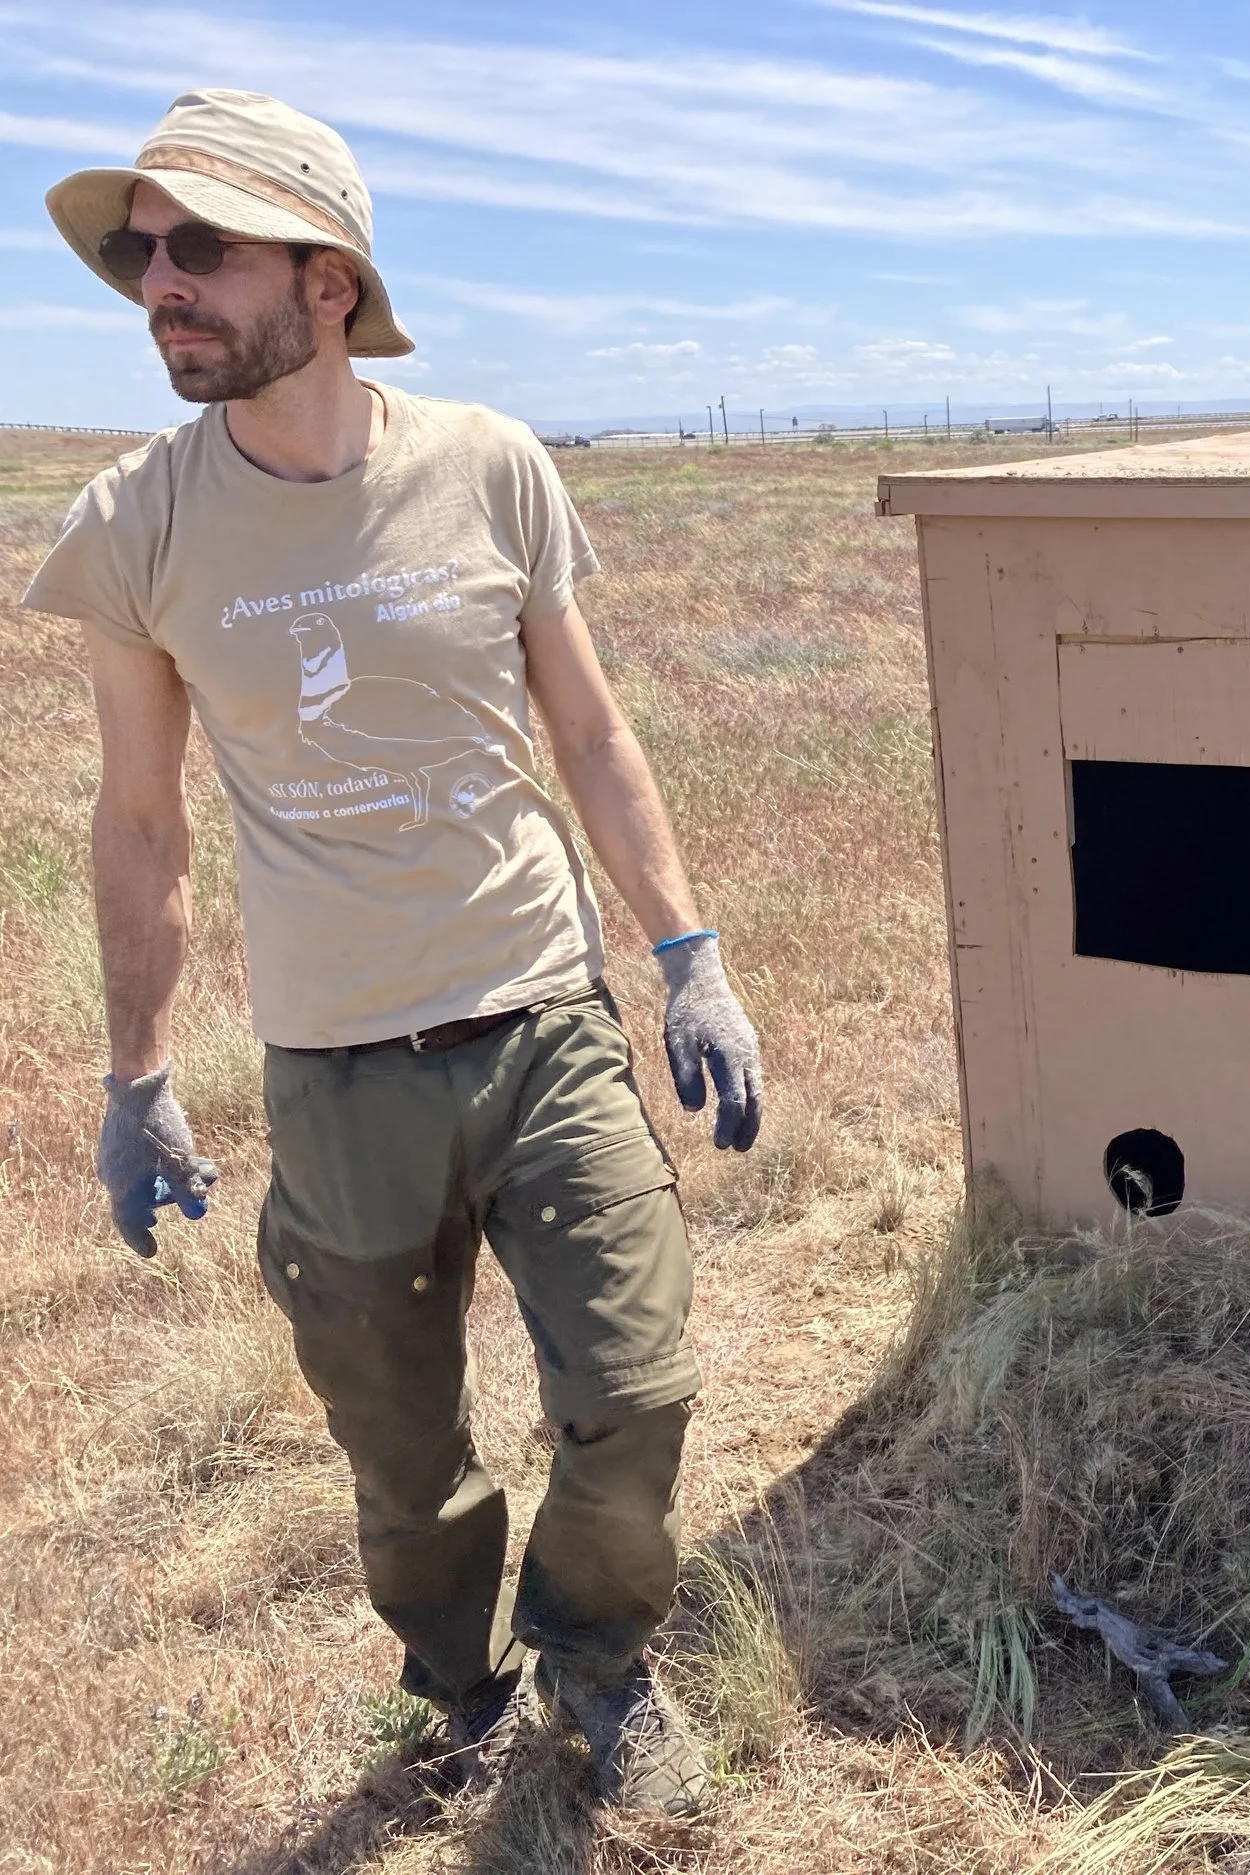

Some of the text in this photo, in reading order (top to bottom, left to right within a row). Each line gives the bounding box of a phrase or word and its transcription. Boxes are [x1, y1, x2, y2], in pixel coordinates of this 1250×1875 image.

[220, 593, 294, 629] ¿Aves
[322, 809, 332, 818] a
[333, 793, 410, 819] conservarlas
